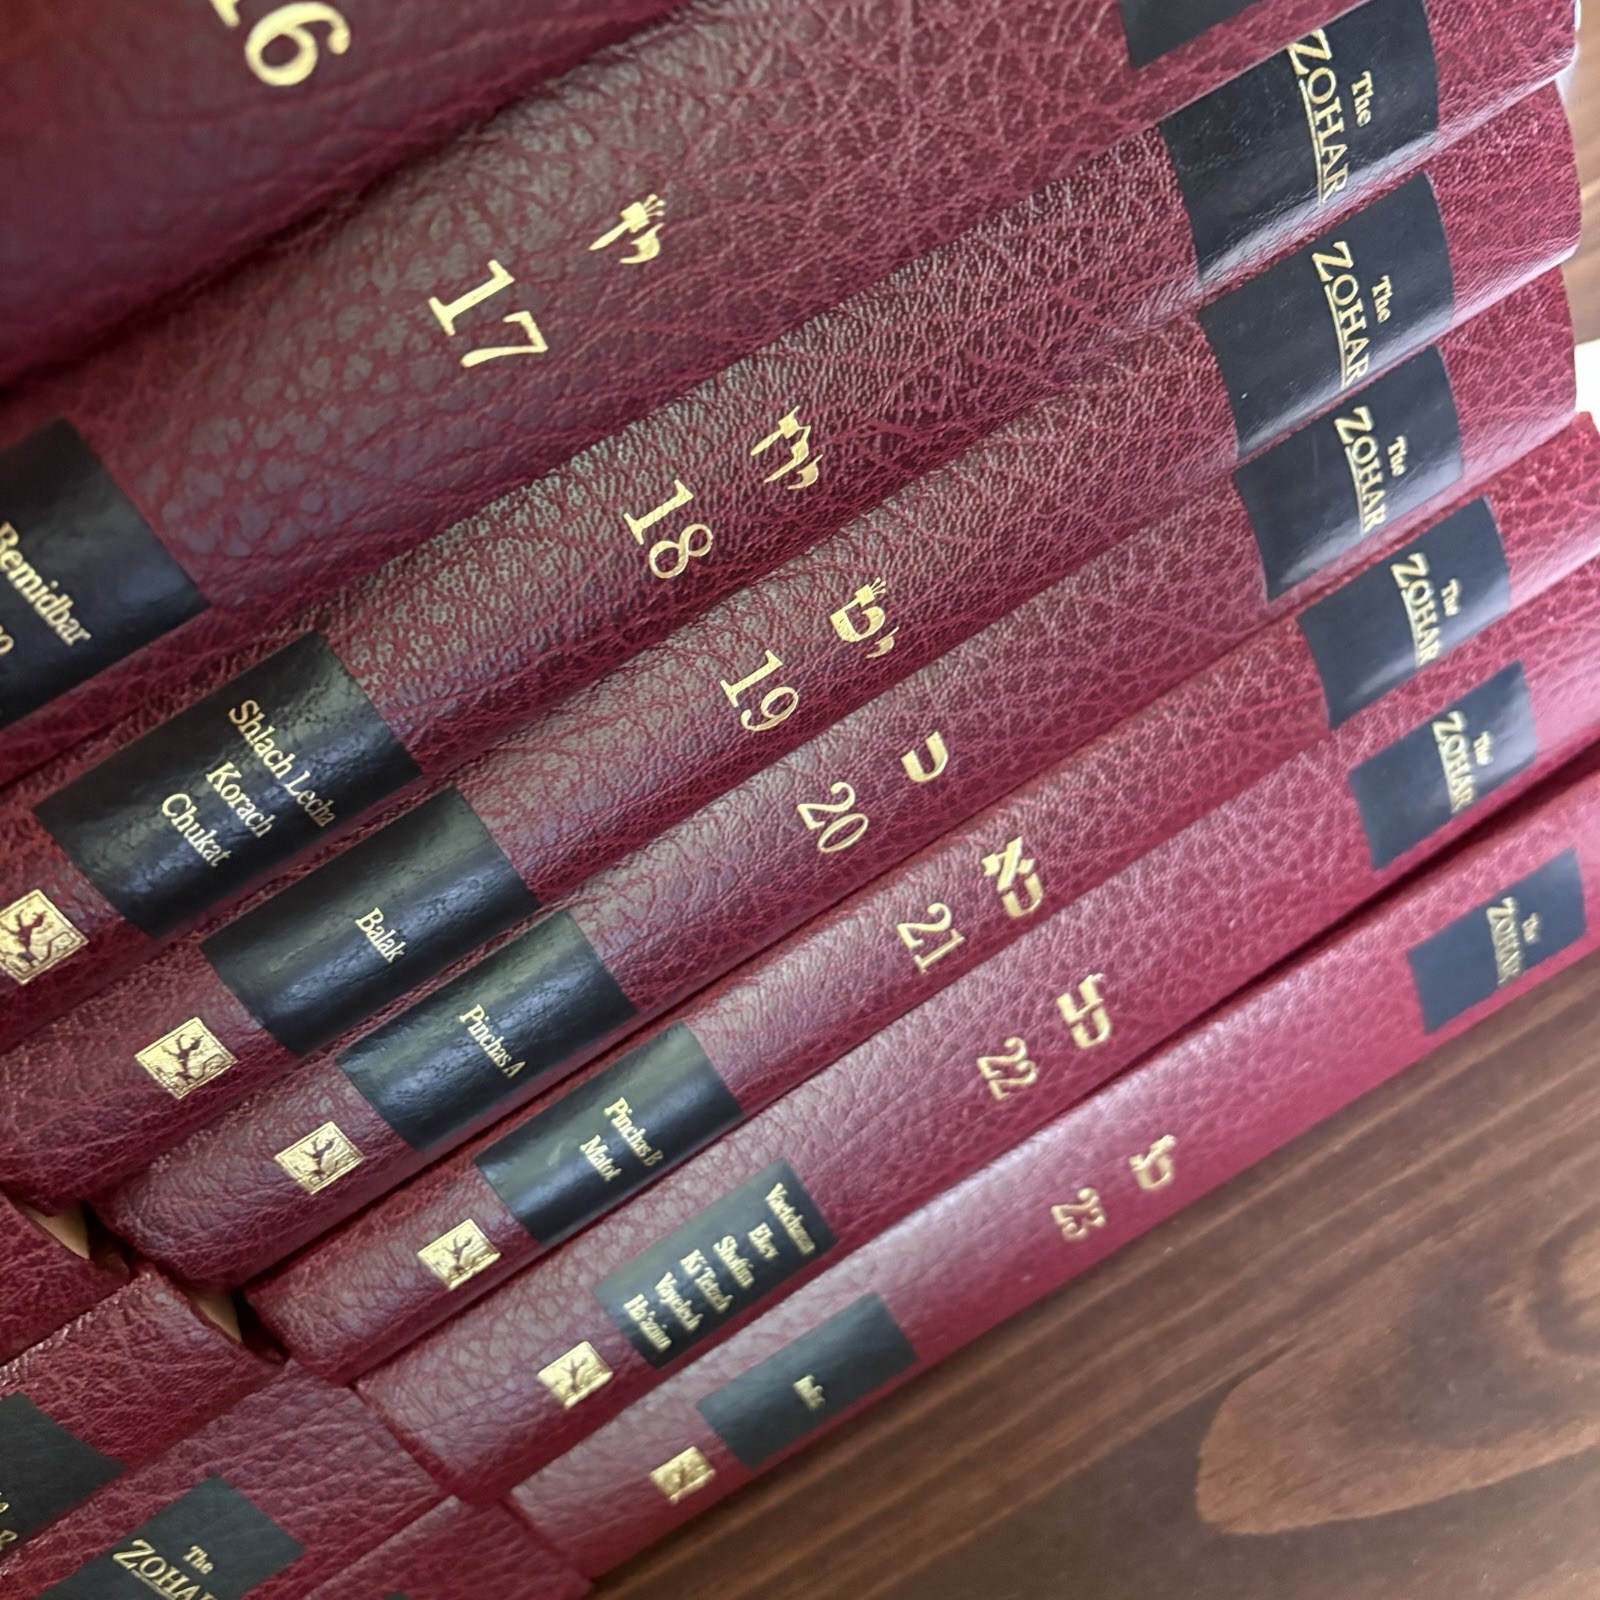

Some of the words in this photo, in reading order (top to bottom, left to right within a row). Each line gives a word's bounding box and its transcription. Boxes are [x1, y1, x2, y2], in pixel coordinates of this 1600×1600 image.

[210, 0, 350, 87] 6
[1286, 28, 1350, 203] ZOHAR
[1352, 70, 1374, 127] The
[588, 194, 666, 264] יז
[428, 259, 549, 368] 17
[1311, 241, 1370, 386] ZOHAR
[1371, 275, 1393, 324] The
[1333, 405, 1387, 533] ZOHAR
[1387, 435, 1407, 476] The
[623, 479, 714, 579] 18
[830, 577, 899, 659] יט
[1390, 552, 1442, 667] ZOHAR
[1441, 578, 1460, 617] The
[720, 650, 799, 731] 19
[228, 699, 296, 780] Shlach
[283, 769, 336, 828] Lecha
[1432, 710, 1475, 813] ZOHAR
[1473, 731, 1493, 766] The
[162, 793, 232, 867] Chukat
[206, 761, 276, 838] Korach
[797, 782, 869, 853] 20
[981, 836, 1043, 918] כא
[355, 907, 407, 964] Balak
[897, 902, 965, 974] 21
[1486, 896, 1521, 986] ZOHAR
[1521, 911, 1540, 944] The
[459, 1003, 513, 1070] Pinchas
[503, 1061, 526, 1078] A
[976, 1037, 1038, 1100] 22
[580, 1135, 622, 1182] Matot
[604, 1097, 652, 1158] Pinchas
[643, 1149, 664, 1167] B
[1051, 1187, 1107, 1241] 23
[680, 1249, 707, 1276] Ki
[113, 1539, 219, 1600] ZOHA
[183, 1545, 214, 1575] The
